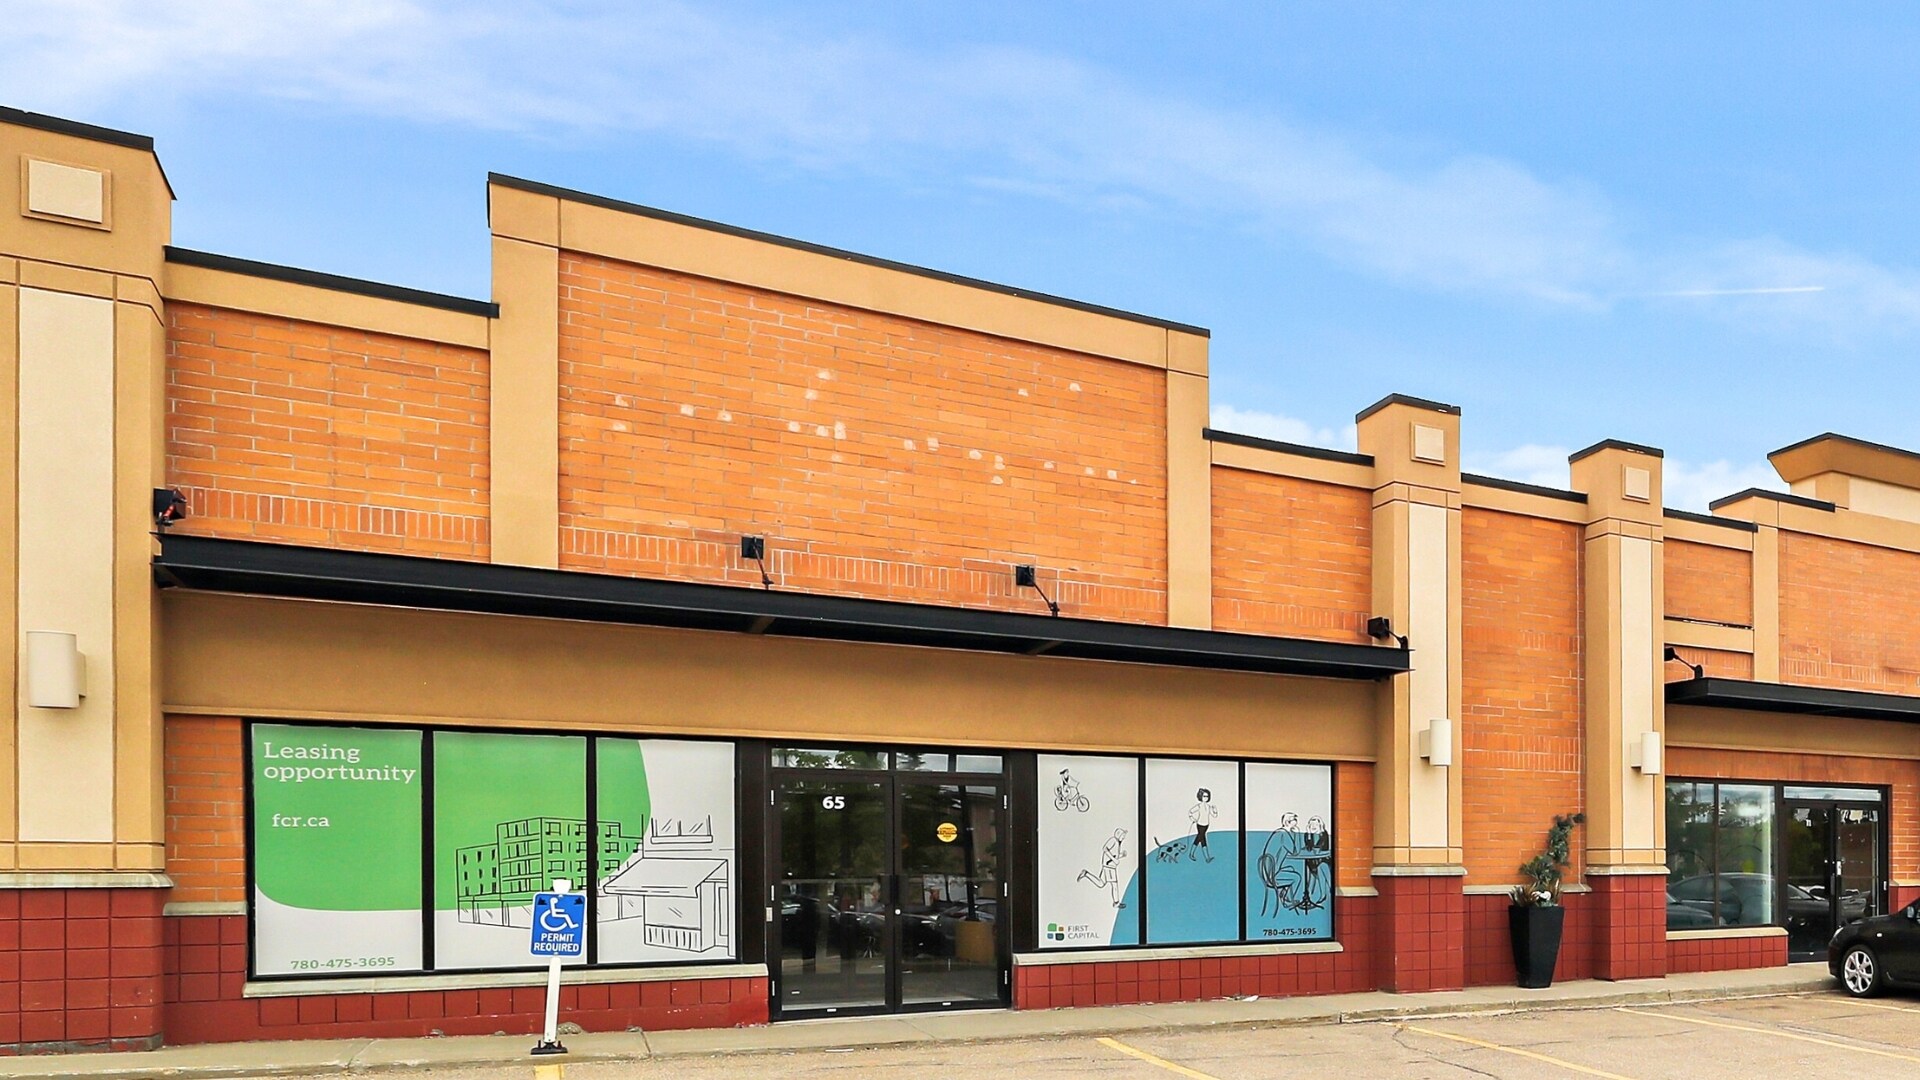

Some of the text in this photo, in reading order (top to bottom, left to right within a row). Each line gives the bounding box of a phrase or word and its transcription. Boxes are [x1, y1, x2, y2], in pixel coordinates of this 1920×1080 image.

[263, 742, 360, 764] Leasing
[263, 765, 417, 784] opportunity
[822, 795, 845, 810] 65
[271, 813, 330, 828] fcr.ca
[540, 932, 575, 943] PERMIT
[1067, 932, 1100, 940] CAPITAL
[1262, 927, 1317, 937] 780-475-3695
[533, 942, 580, 953] REQUIRED
[290, 956, 396, 970] 780-475-3695
